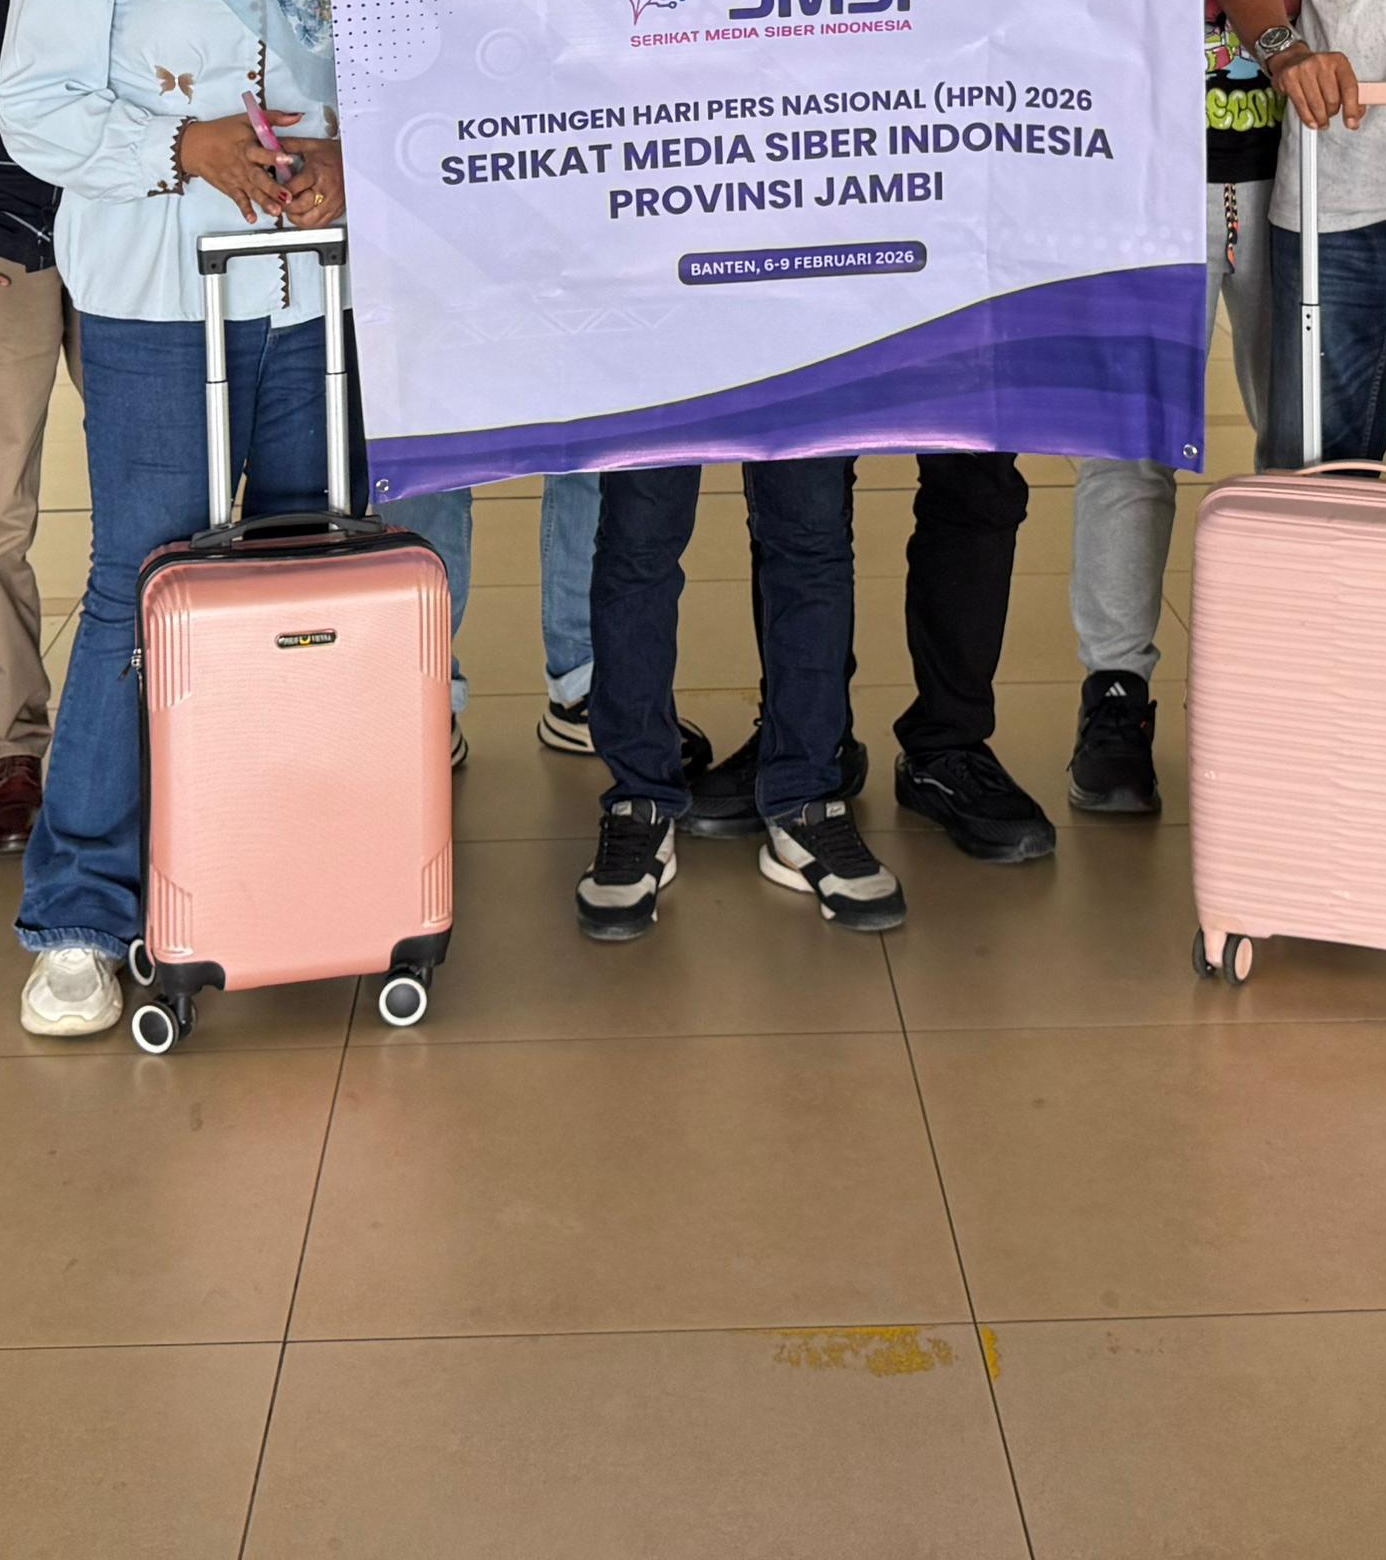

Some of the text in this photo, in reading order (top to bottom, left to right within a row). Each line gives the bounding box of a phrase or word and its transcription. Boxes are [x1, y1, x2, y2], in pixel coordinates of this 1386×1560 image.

[630, 19, 913, 48] SERIKAT MEDIA SIBER INDONESIA
[458, 81, 1092, 140] KONTINGEN HARI PERS NASIONAL (HPN) 2026
[441, 122, 1114, 185] SERIKAT MEDIA SIBER INDONESIA
[609, 171, 943, 219] PROVINSI JAMBI
[691, 250, 914, 276] BANTEN, 6-9 FEBRUARI 2026
